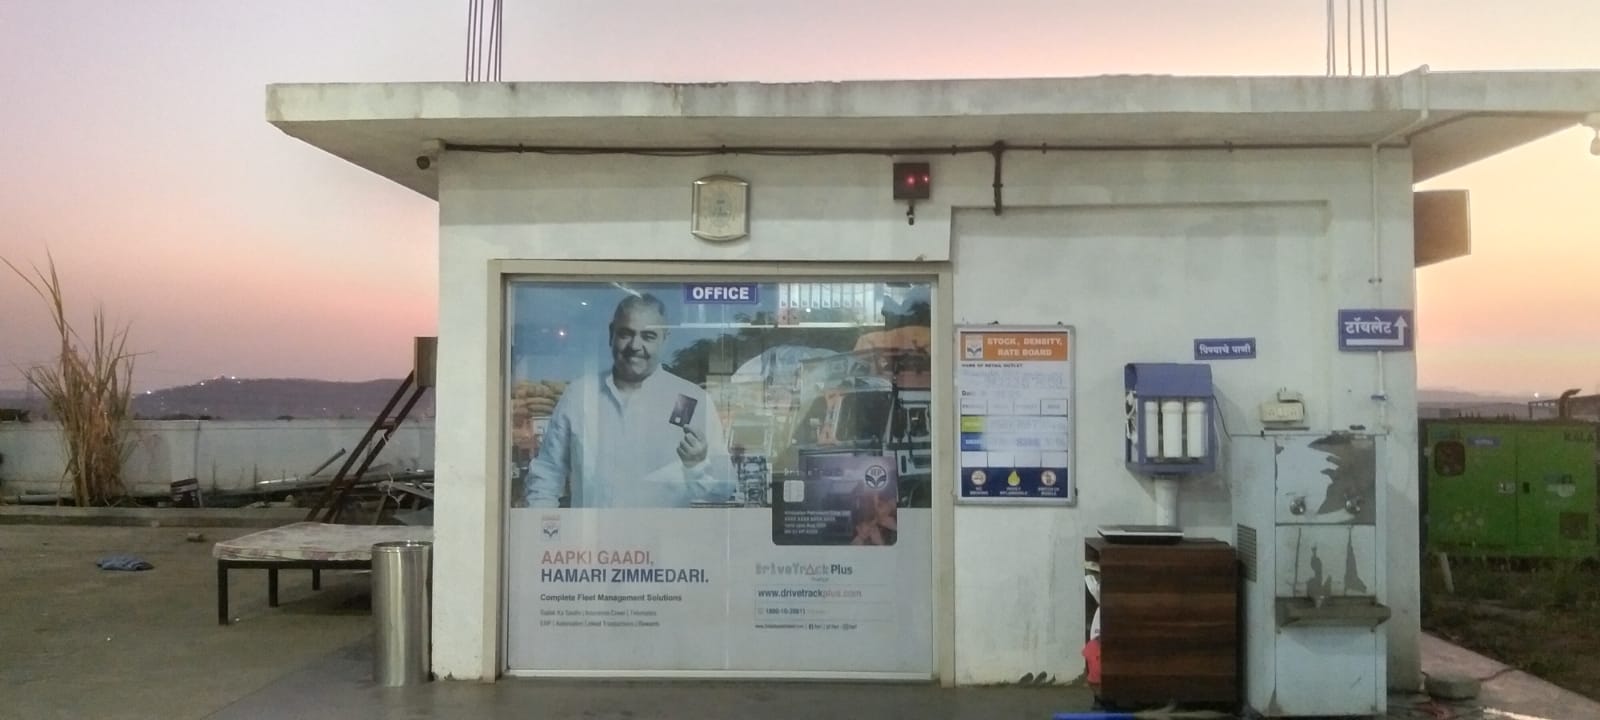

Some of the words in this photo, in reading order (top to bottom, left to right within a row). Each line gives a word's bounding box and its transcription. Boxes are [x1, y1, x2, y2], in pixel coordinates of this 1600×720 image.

[692, 287, 749, 300] OFFICE
[1344, 316, 1392, 333] टॉयलेट
[997, 348, 1019, 357] RATE
[1022, 348, 1053, 357] BOARD
[541, 550, 592, 565] AAPKI
[597, 550, 655, 567] GAADI,
[541, 568, 606, 583] HAMARI
[611, 568, 709, 583] ZIMMEDARI.
[540, 593, 575, 602] Complete
[577, 593, 596, 601] Fleet
[597, 594, 645, 603] Management
[758, 588, 862, 599] www.drivetrackplus.com
